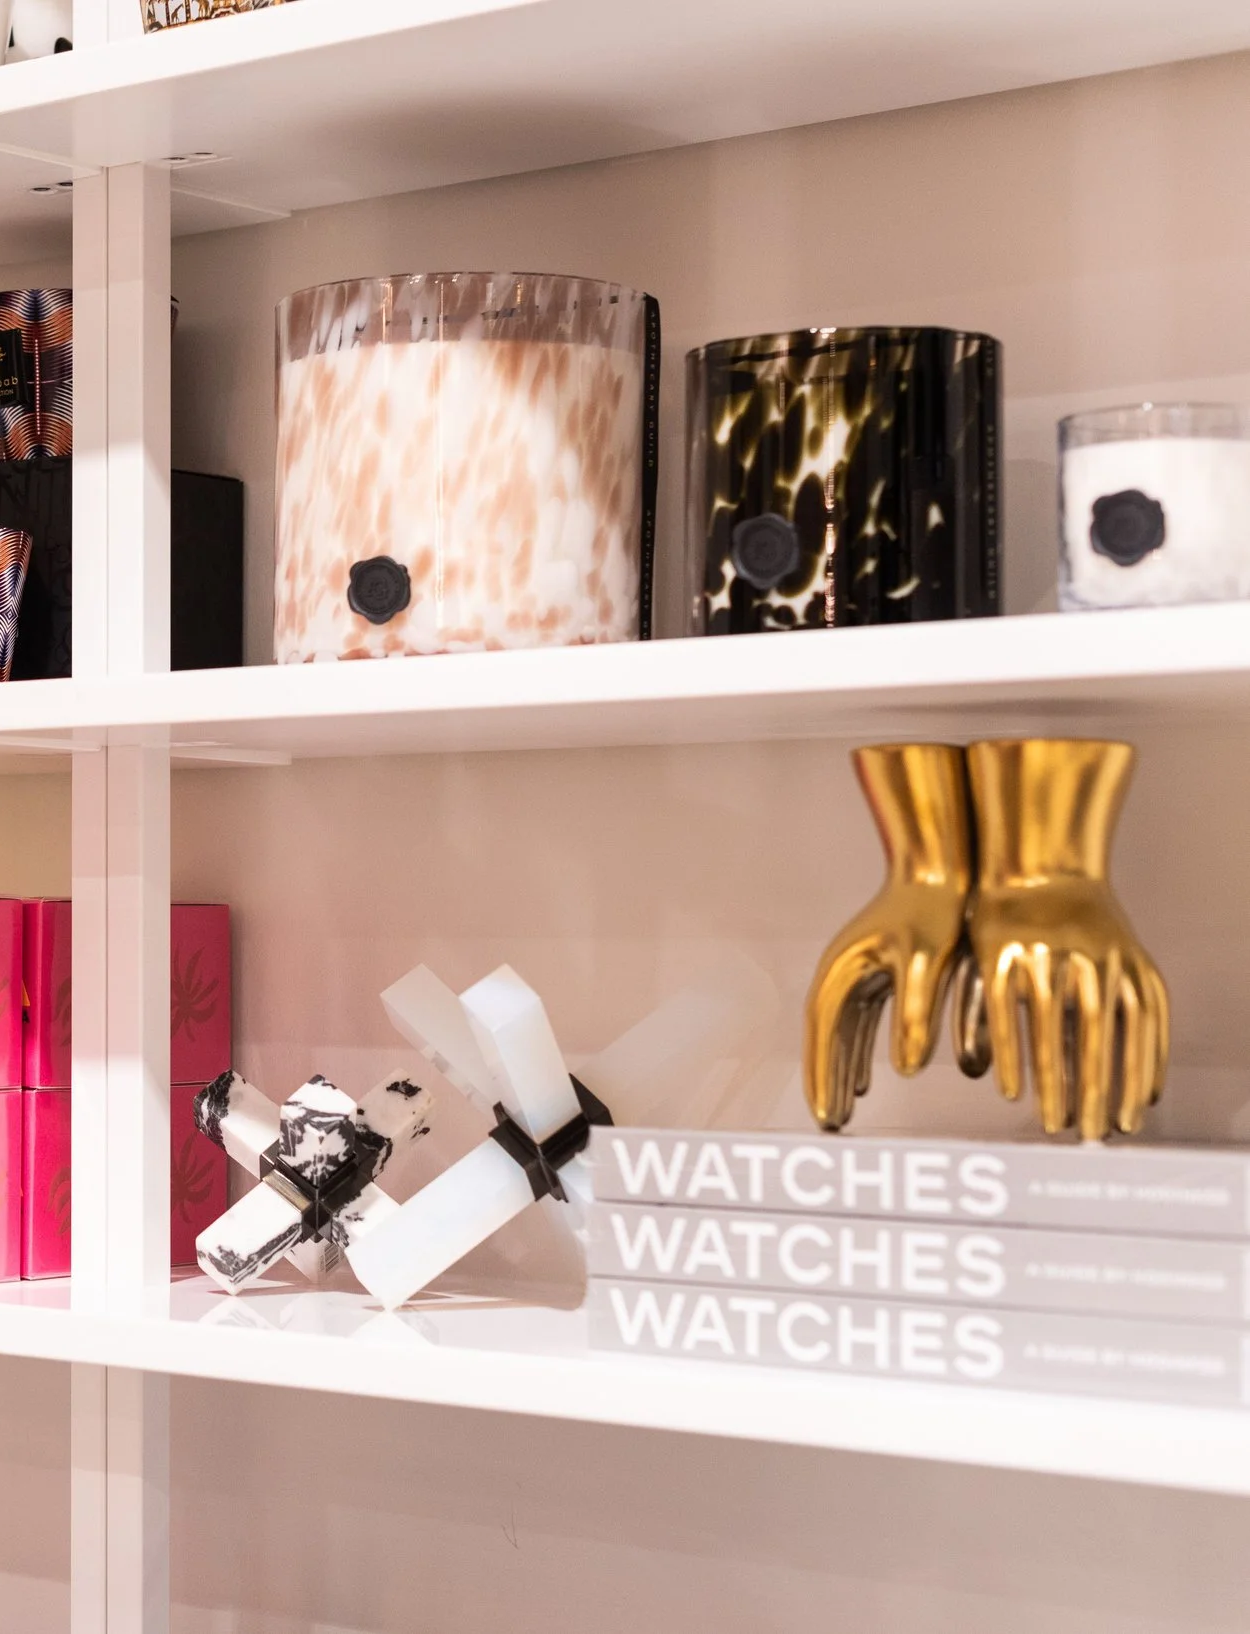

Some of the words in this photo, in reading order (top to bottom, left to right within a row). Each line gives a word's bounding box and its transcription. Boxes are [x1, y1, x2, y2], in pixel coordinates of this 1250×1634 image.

[611, 1138, 1009, 1217] WATCHES
[610, 1213, 1007, 1298] WATCHES
[610, 1286, 1004, 1380] WATCHES
